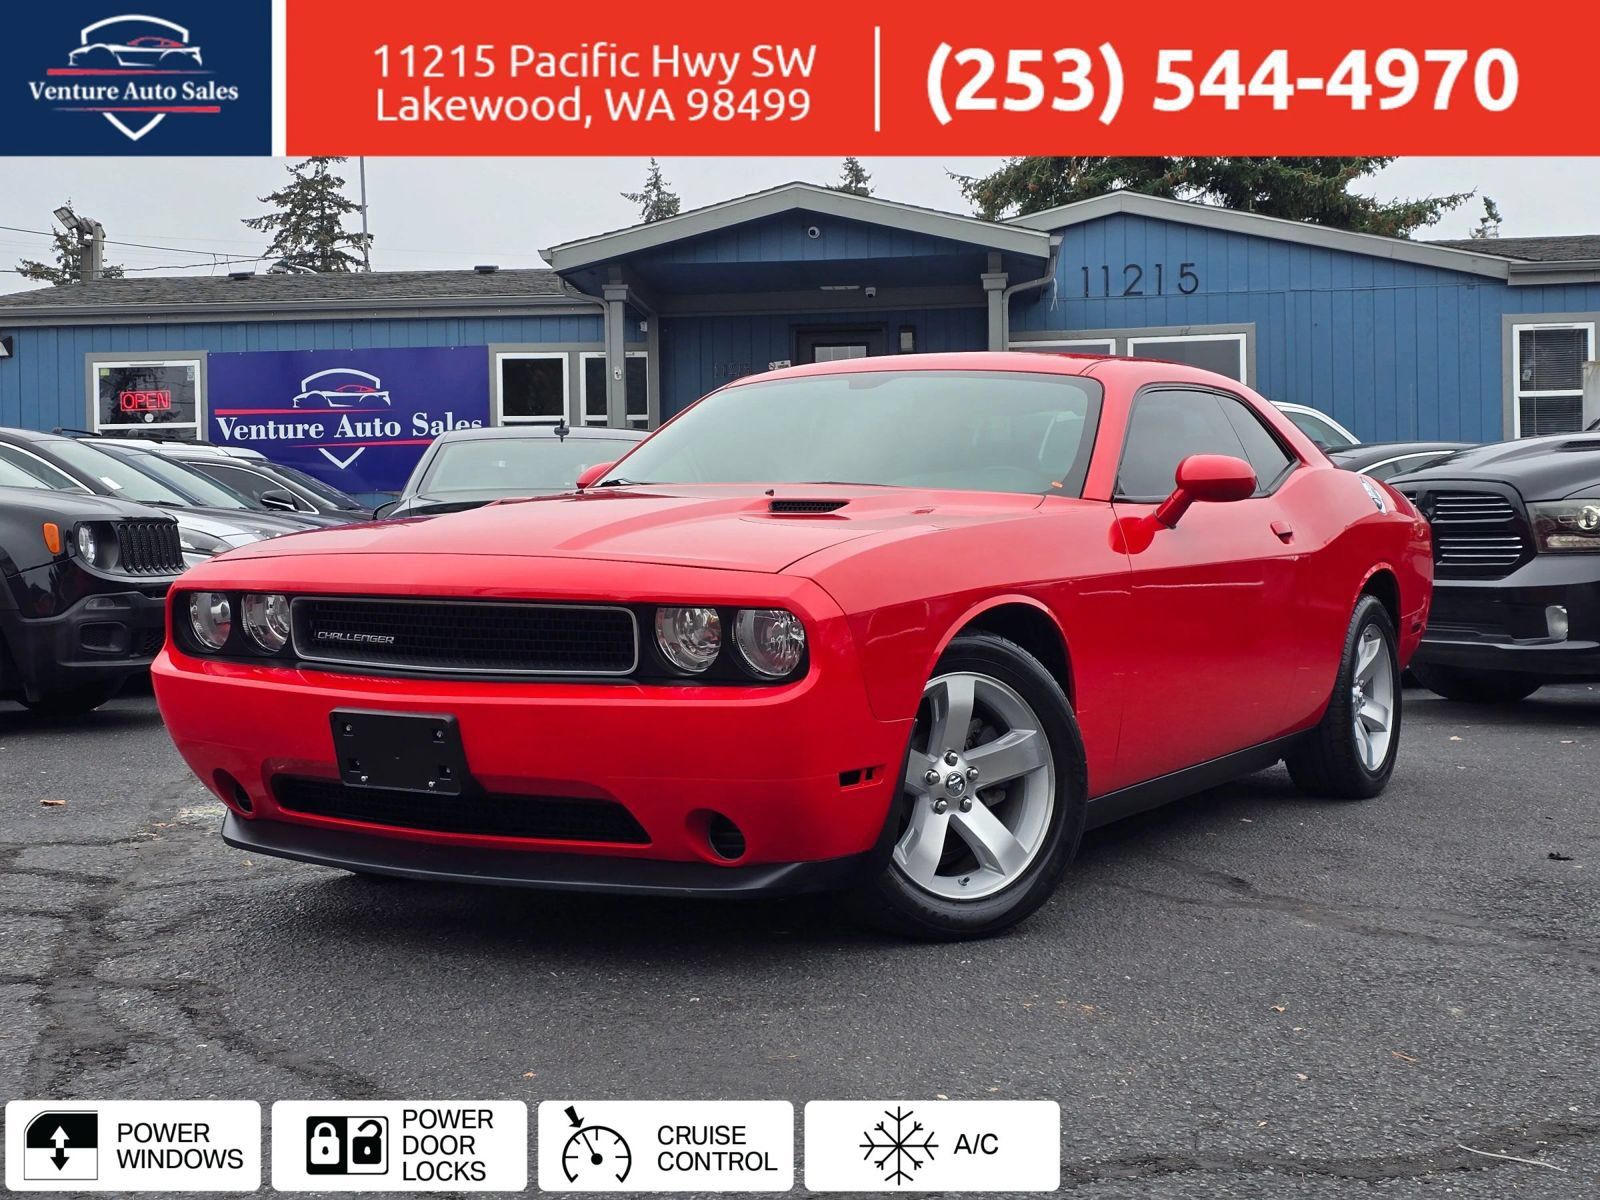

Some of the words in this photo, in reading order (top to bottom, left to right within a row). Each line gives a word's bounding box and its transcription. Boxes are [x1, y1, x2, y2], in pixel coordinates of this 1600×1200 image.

[1081, 262, 1199, 298] 11215
[122, 392, 169, 410] OPEN
[215, 416, 325, 441] Venture
[333, 413, 402, 438] Auto
[412, 411, 483, 437] Sales
[317, 631, 395, 644] CHALLENGER
